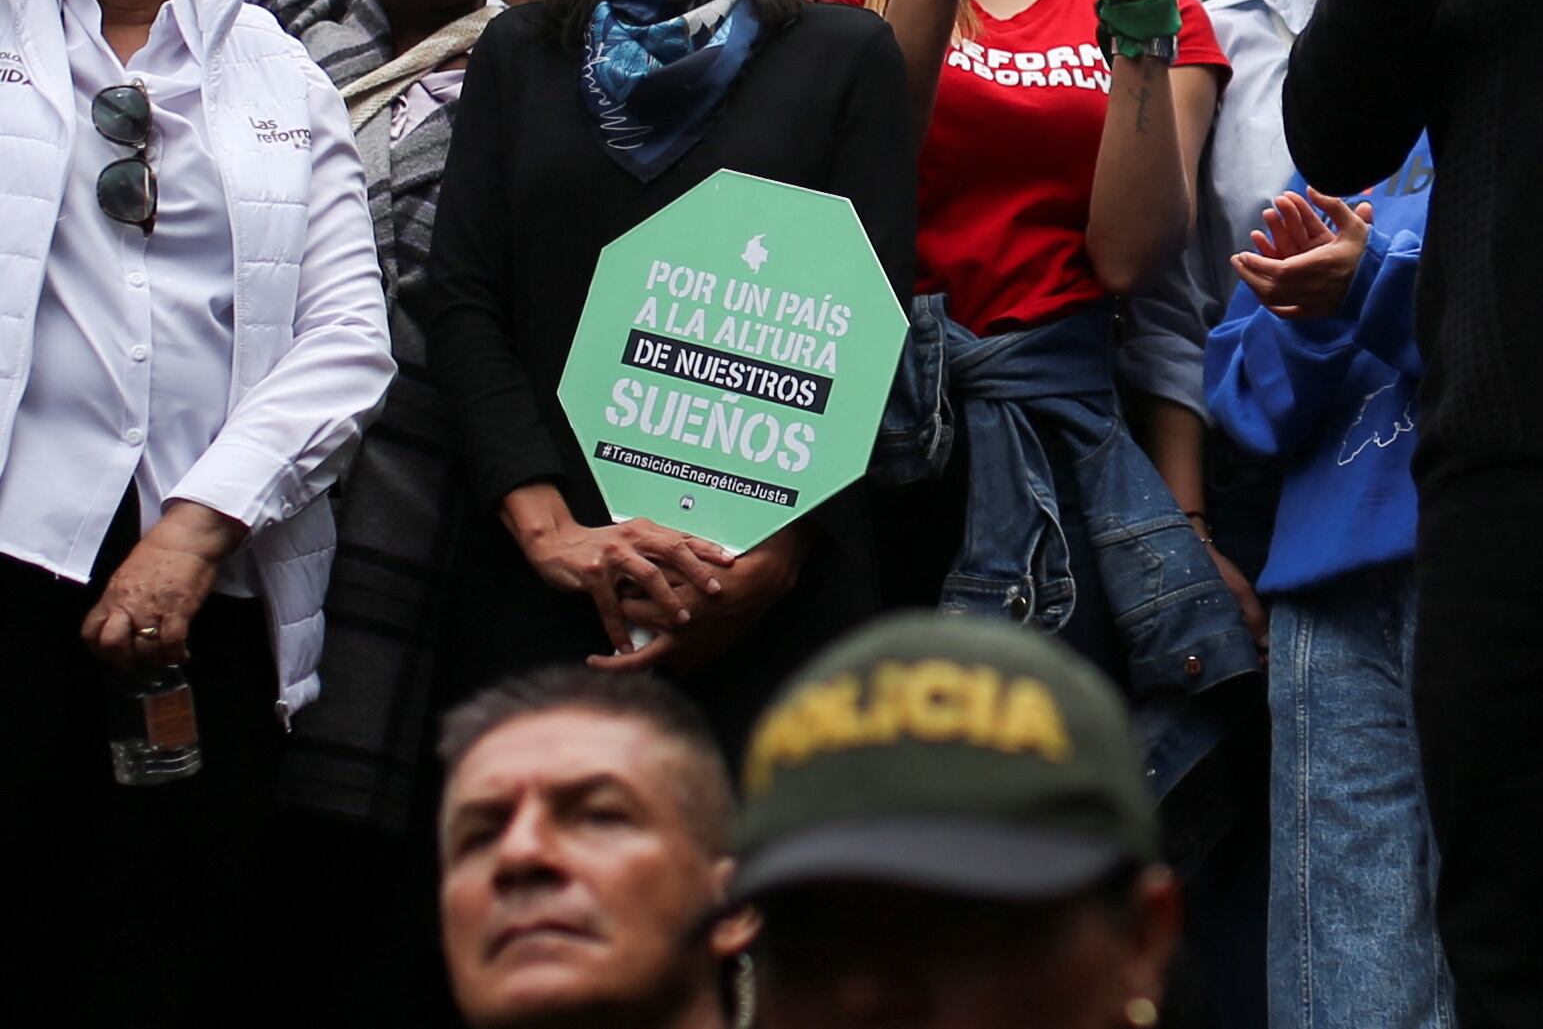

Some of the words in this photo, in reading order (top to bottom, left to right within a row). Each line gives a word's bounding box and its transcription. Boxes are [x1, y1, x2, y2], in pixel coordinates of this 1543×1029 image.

[248, 116, 278, 130] Las
[634, 296, 657, 328] A
[665, 303, 706, 341] LA
[712, 316, 838, 373] ALTURA
[646, 260, 717, 304] POR
[723, 278, 771, 317] UN
[775, 293, 852, 338] PAÍS
[633, 338, 671, 370] DE
[674, 347, 818, 407] NUESTROS
[605, 377, 816, 473] SUEÑOS
[601, 444, 788, 506] #TransiciónEnergéticaJusta
